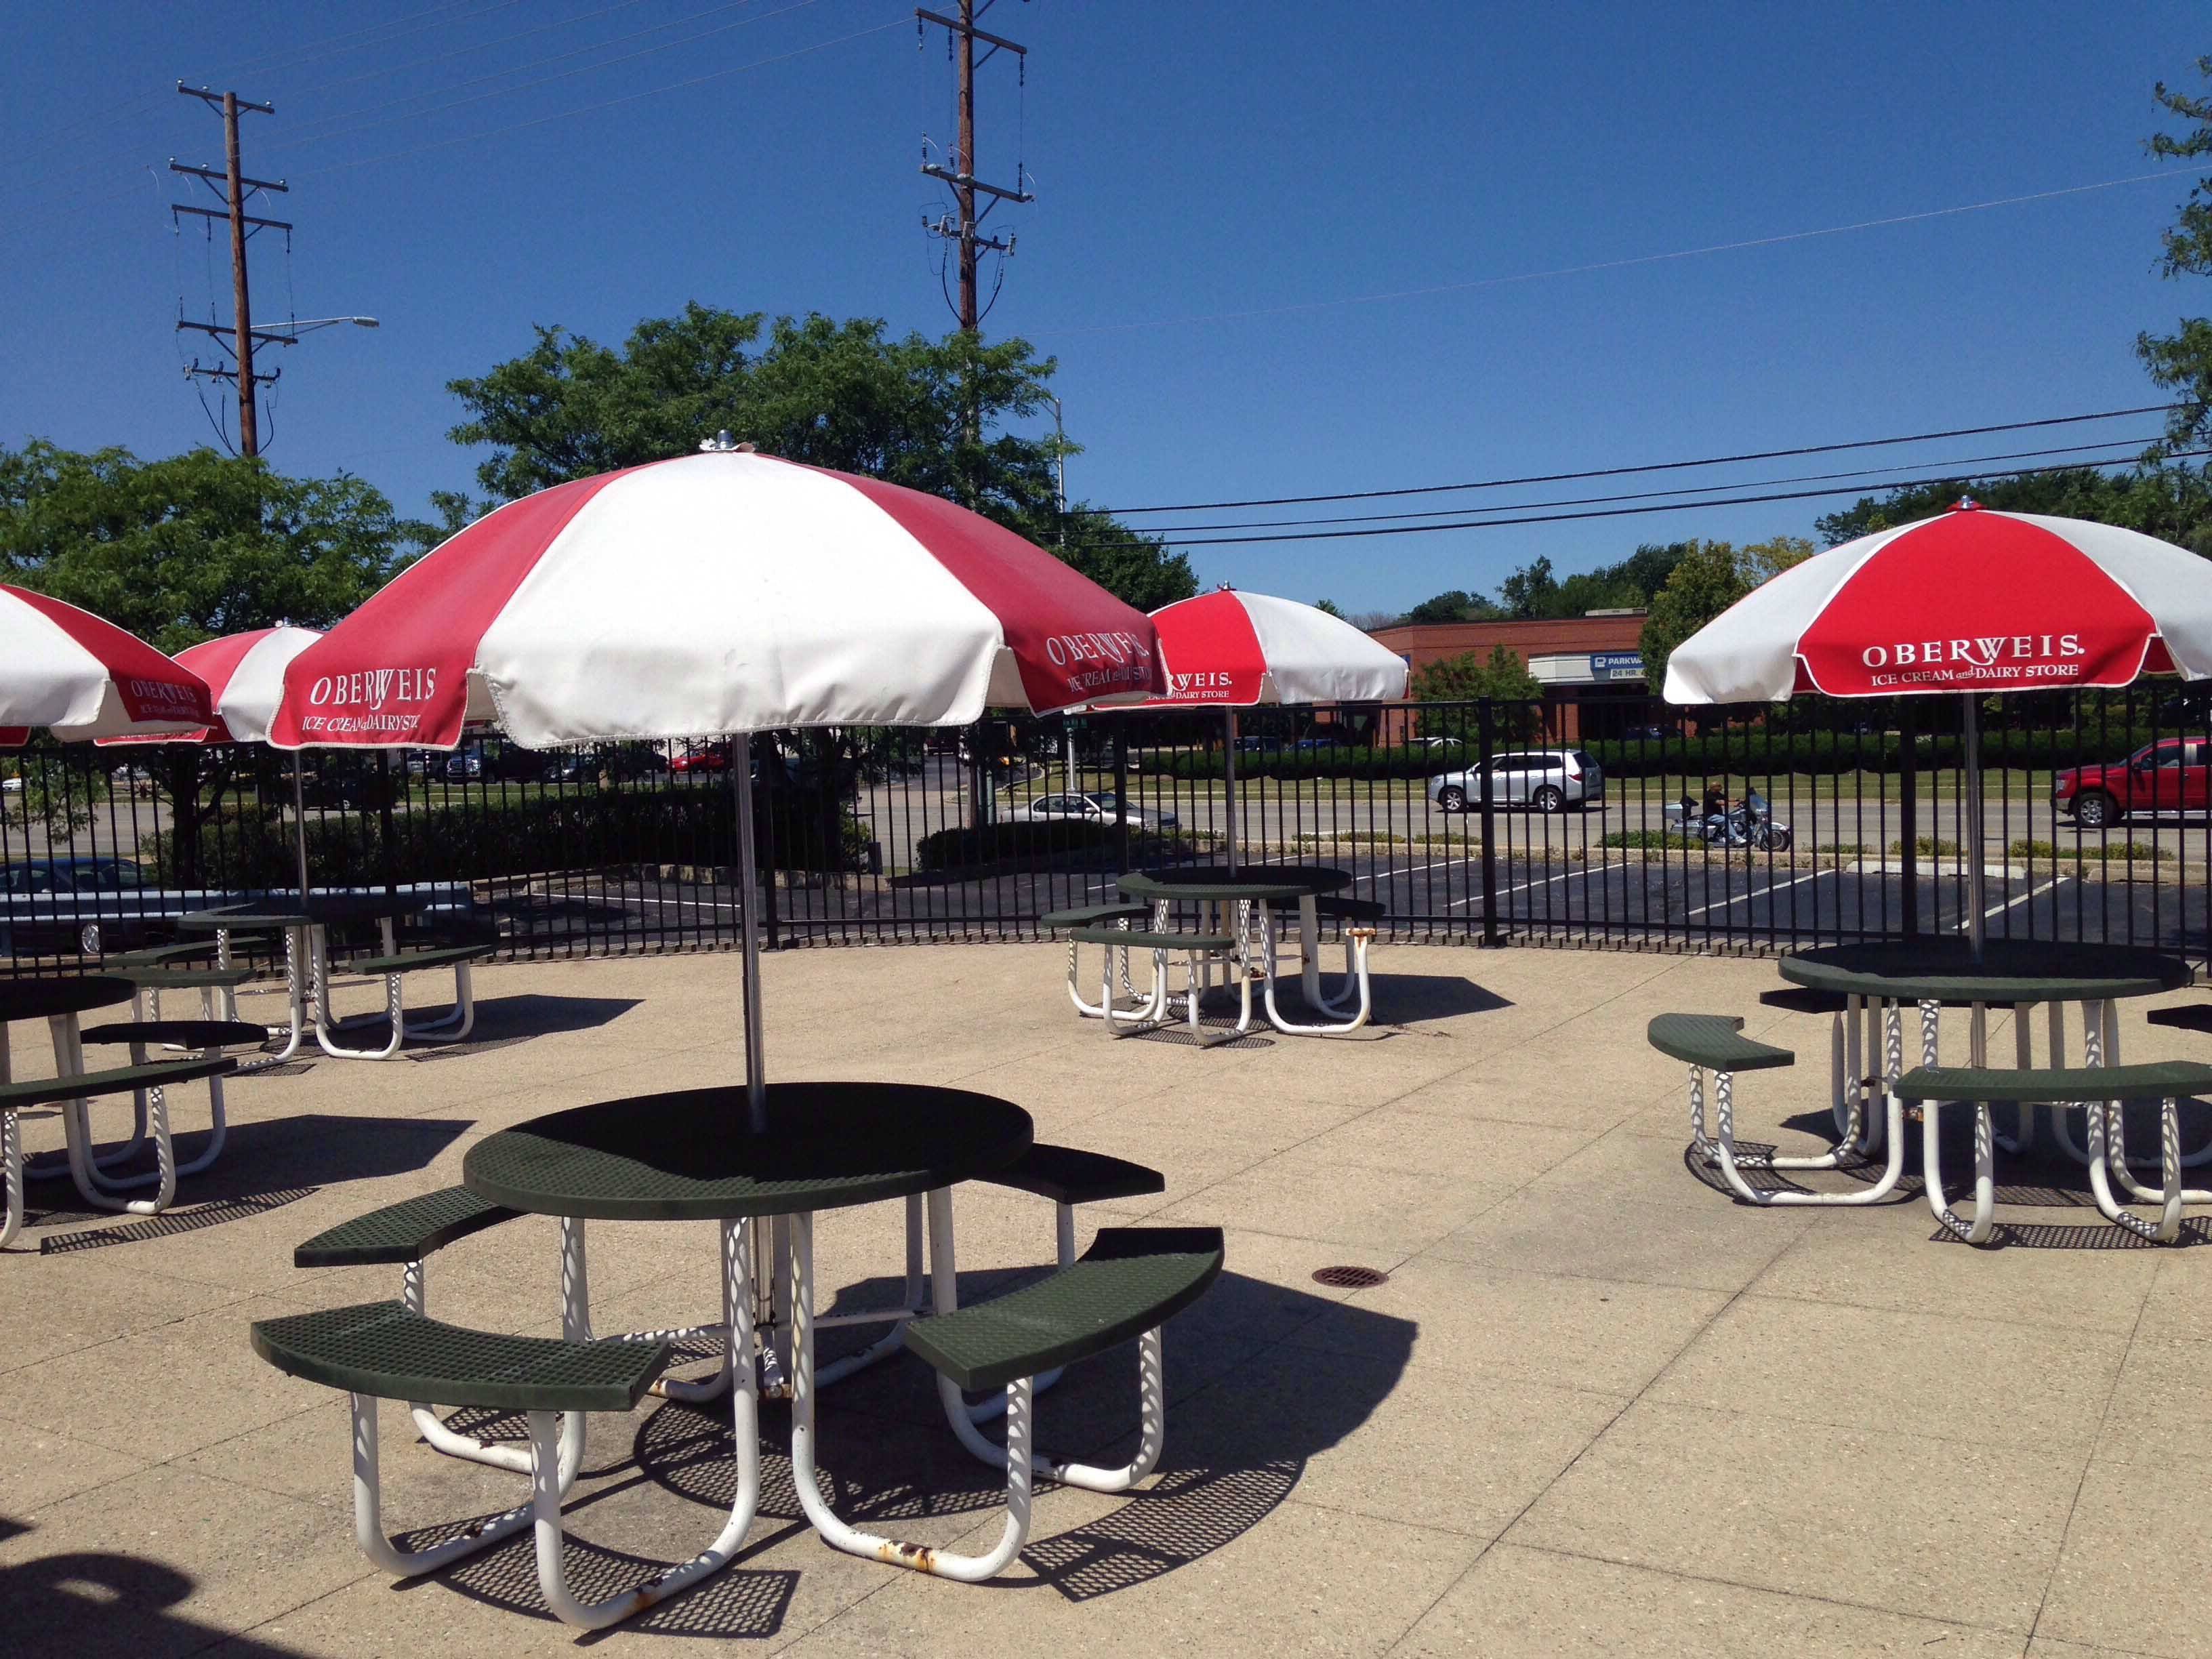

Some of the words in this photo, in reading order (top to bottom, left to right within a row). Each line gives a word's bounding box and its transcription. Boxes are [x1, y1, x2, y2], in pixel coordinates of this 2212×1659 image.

[1871, 674, 1898, 686] ICE
[1902, 670, 1954, 683] CREAM
[1956, 665, 1975, 679] and
[1975, 666, 2022, 679] DAIRY
[2026, 664, 2078, 677] STORE
[1176, 691, 1200, 700] DAIRY
[1201, 690, 1229, 699] STORE
[302, 717, 327, 731] ICE
[367, 714, 403, 731] DAIRY
